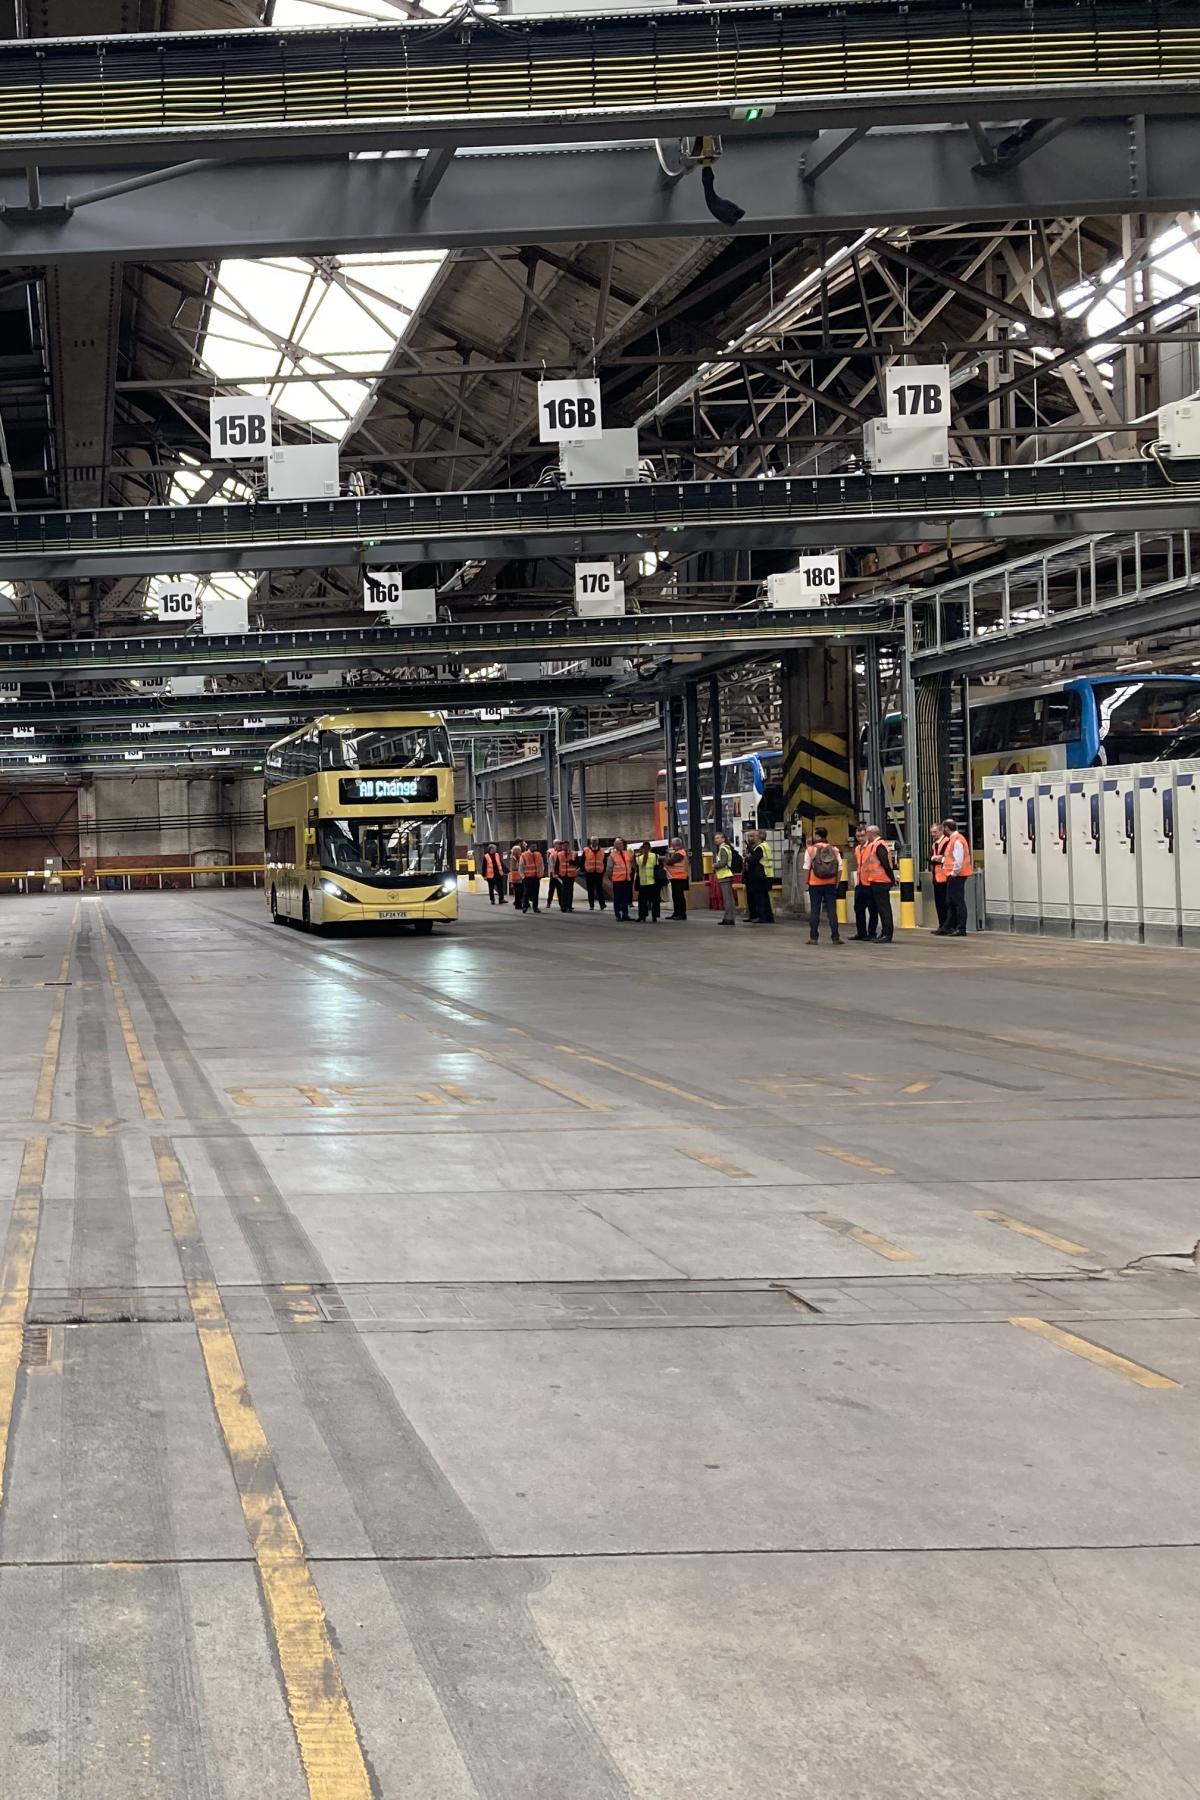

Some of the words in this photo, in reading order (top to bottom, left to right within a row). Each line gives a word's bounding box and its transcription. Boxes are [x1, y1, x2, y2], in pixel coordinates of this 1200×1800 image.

[896, 385, 942, 415] 17B
[543, 398, 597, 429] 16B
[215, 415, 266, 445] 15B
[579, 574, 610, 594] 17C
[803, 567, 835, 587] 18C
[161, 593, 192, 613] 15C
[367, 584, 399, 603] 16C
[527, 746, 538, 755] 19
[359, 782, 374, 797] All
[376, 780, 418, 796] Change
